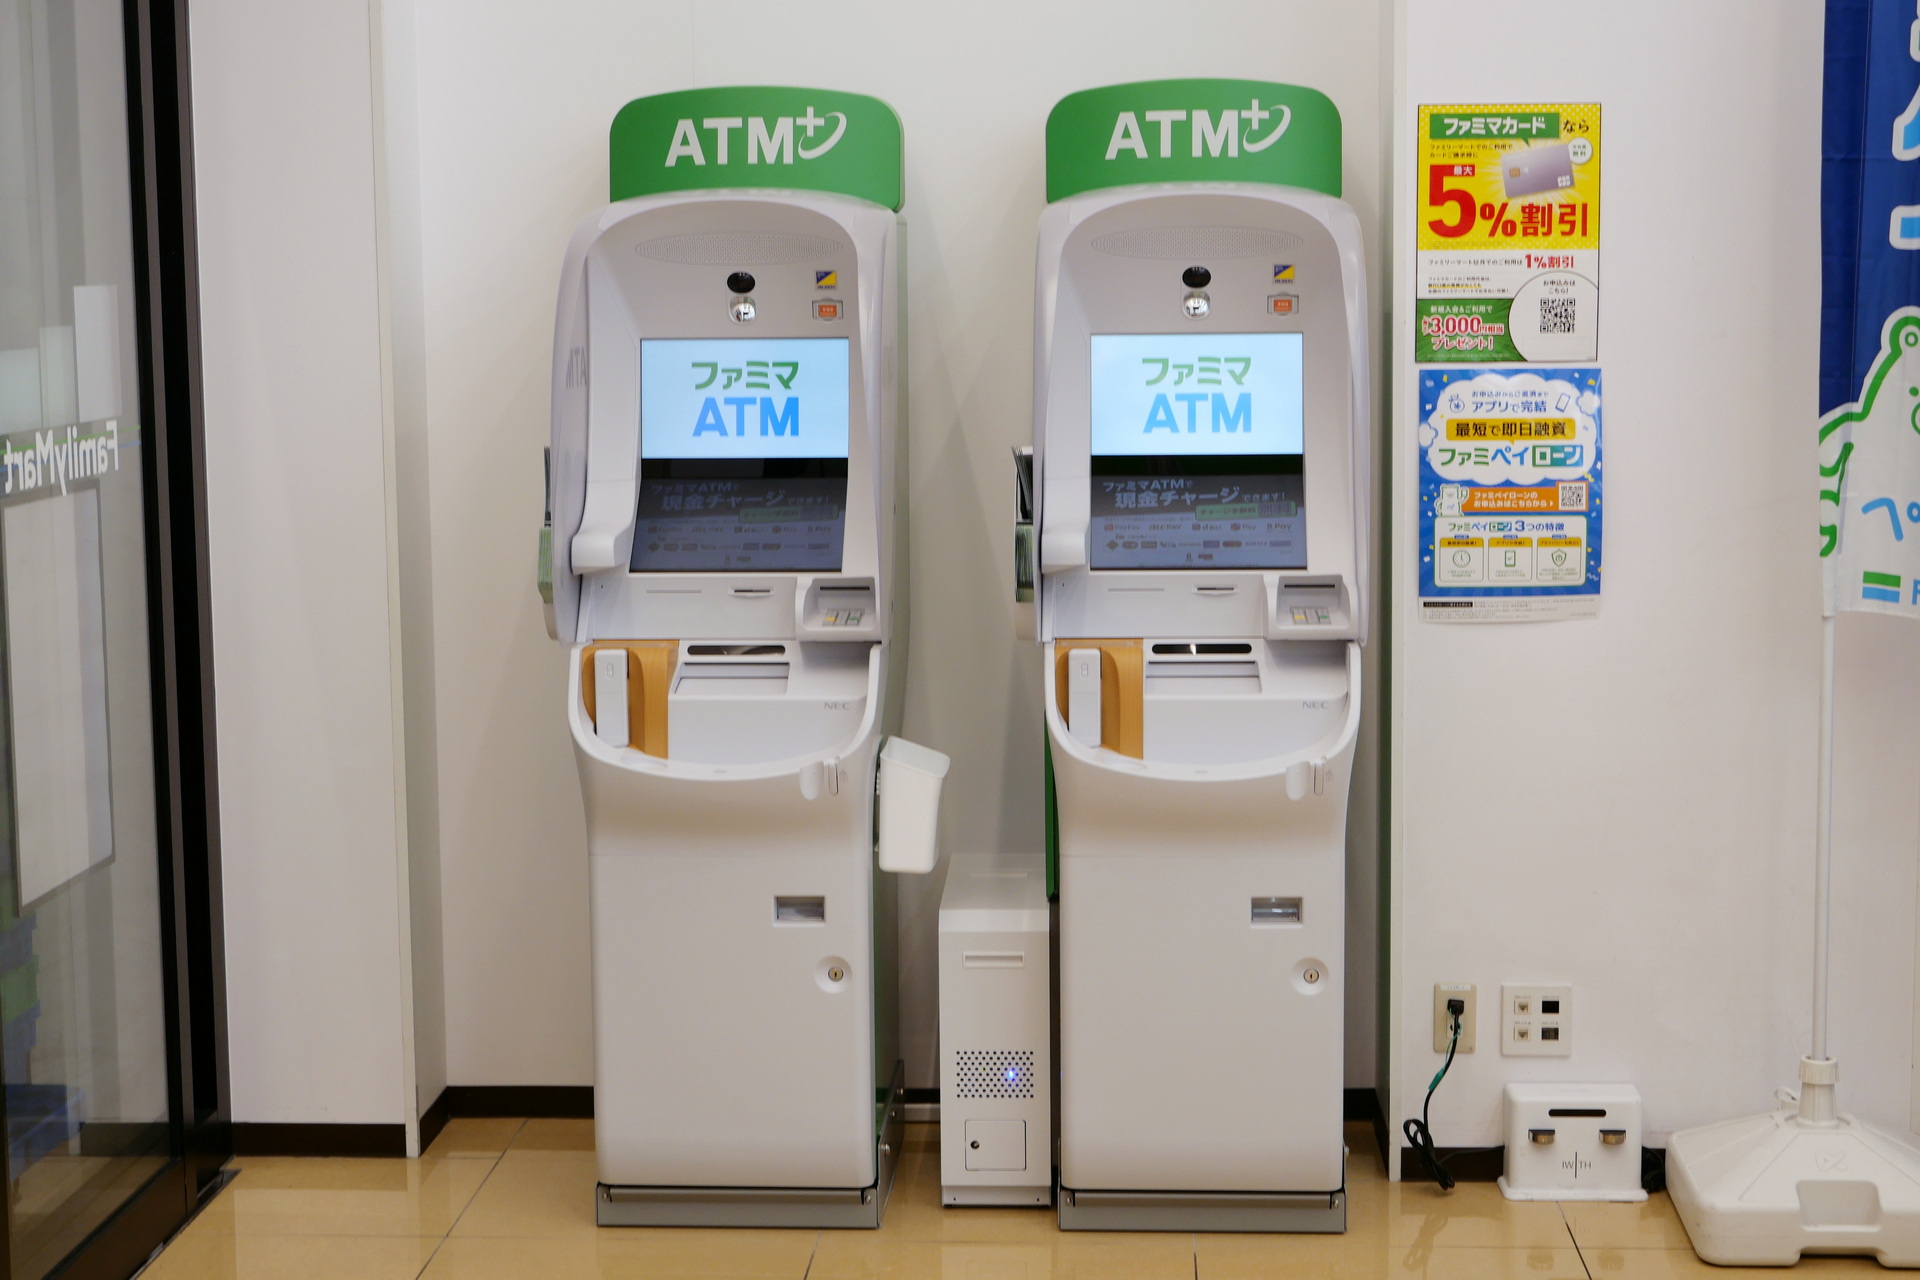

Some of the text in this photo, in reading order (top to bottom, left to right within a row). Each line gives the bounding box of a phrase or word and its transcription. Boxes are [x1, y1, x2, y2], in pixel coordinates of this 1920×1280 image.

[1444, 116, 1589, 136] ファミマカード なら
[1453, 165, 1473, 176] 最大
[1428, 164, 1588, 238] 5%割引
[1525, 253, 1574, 269] 1%割引
[691, 361, 799, 390] ファミマ
[1142, 356, 1252, 386] ファミマ
[692, 397, 799, 436] ATM
[1143, 393, 1252, 433] ATM
[1471, 400, 1547, 413] アプリで完結
[1455, 422, 1567, 437] 最短で即日融資
[1438, 445, 1584, 467] ファミペイローン
[1115, 485, 1240, 509] 現金チャージ
[824, 701, 850, 711] NEC
[1302, 700, 1329, 710] NEC
